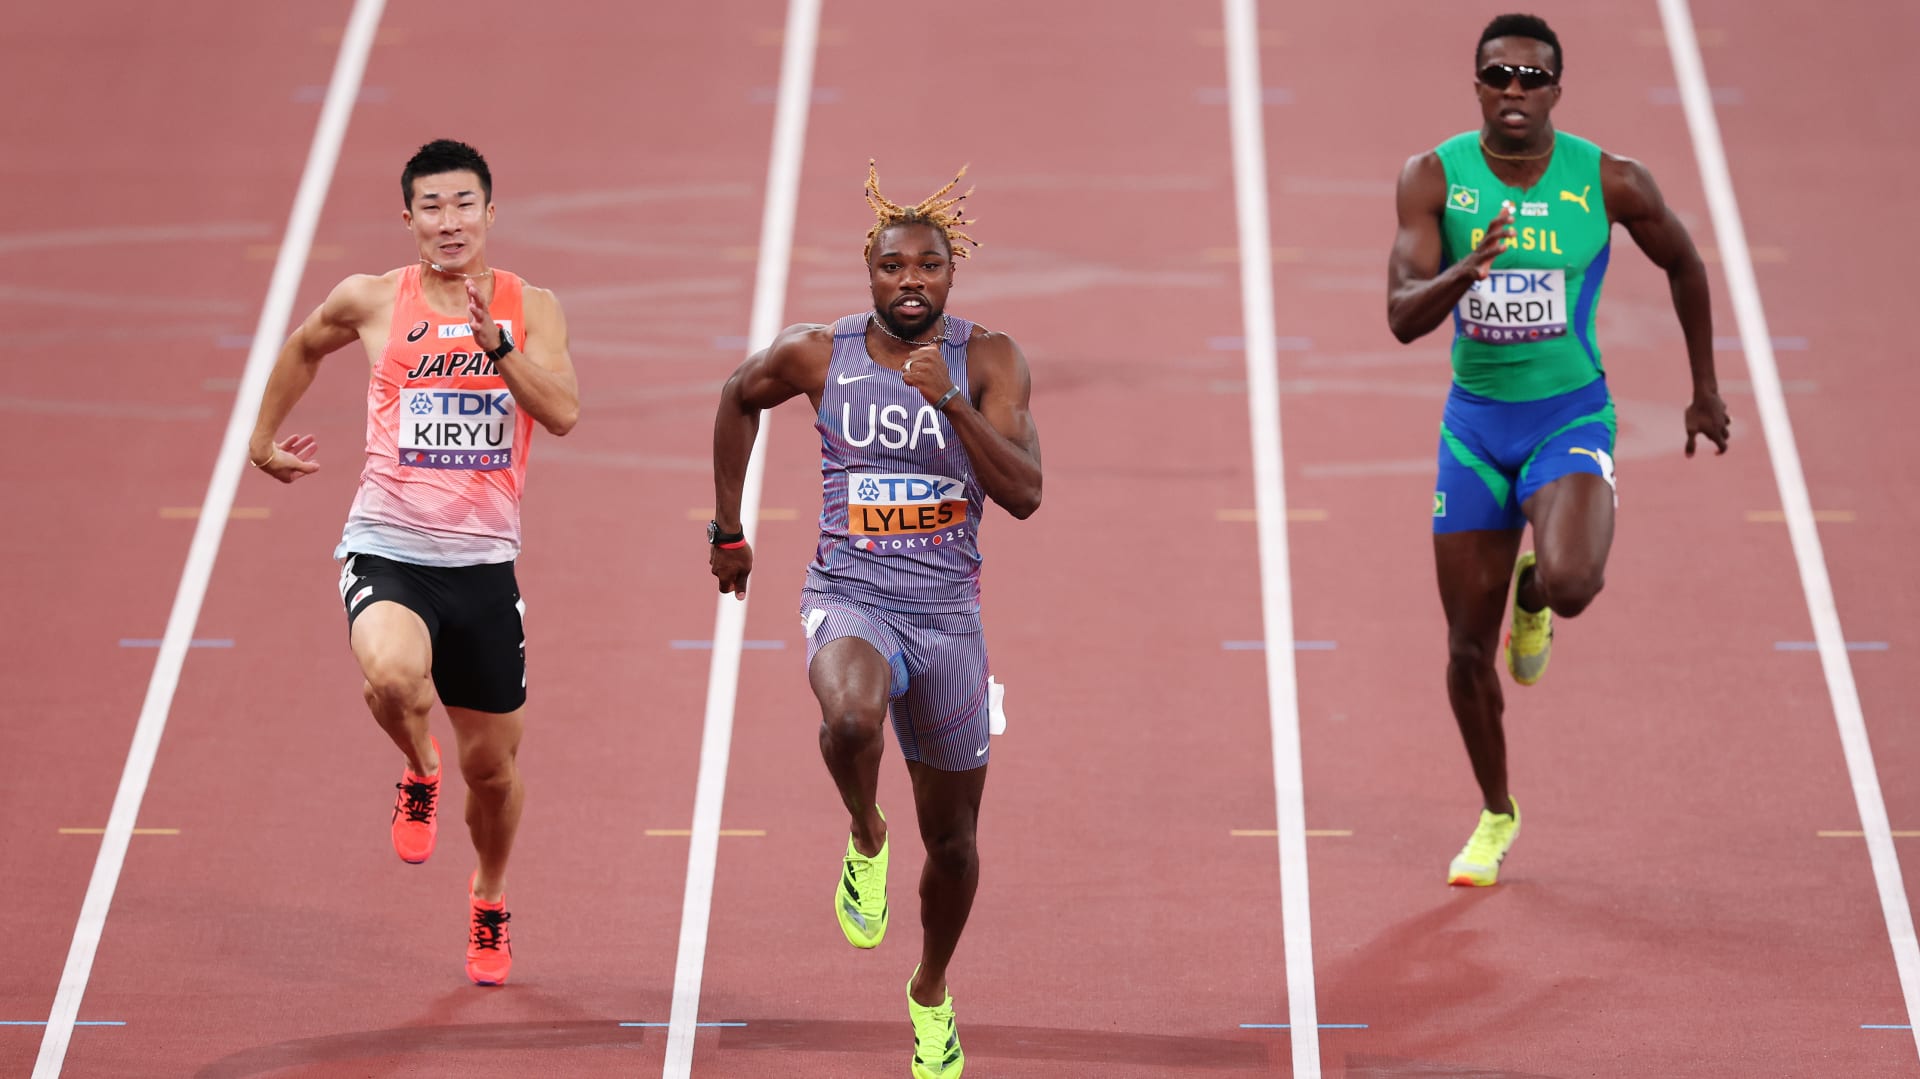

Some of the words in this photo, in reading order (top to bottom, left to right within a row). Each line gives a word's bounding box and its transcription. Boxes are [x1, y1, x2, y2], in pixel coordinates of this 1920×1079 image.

[1471, 227, 1562, 254] BASIL
[1488, 273, 1553, 293] TDK
[1469, 299, 1552, 322] BARDI
[433, 392, 509, 415] TDK
[415, 423, 504, 446] KIRYU
[843, 402, 945, 450] USA
[879, 478, 955, 501] TDK
[863, 503, 953, 531] LYLES
